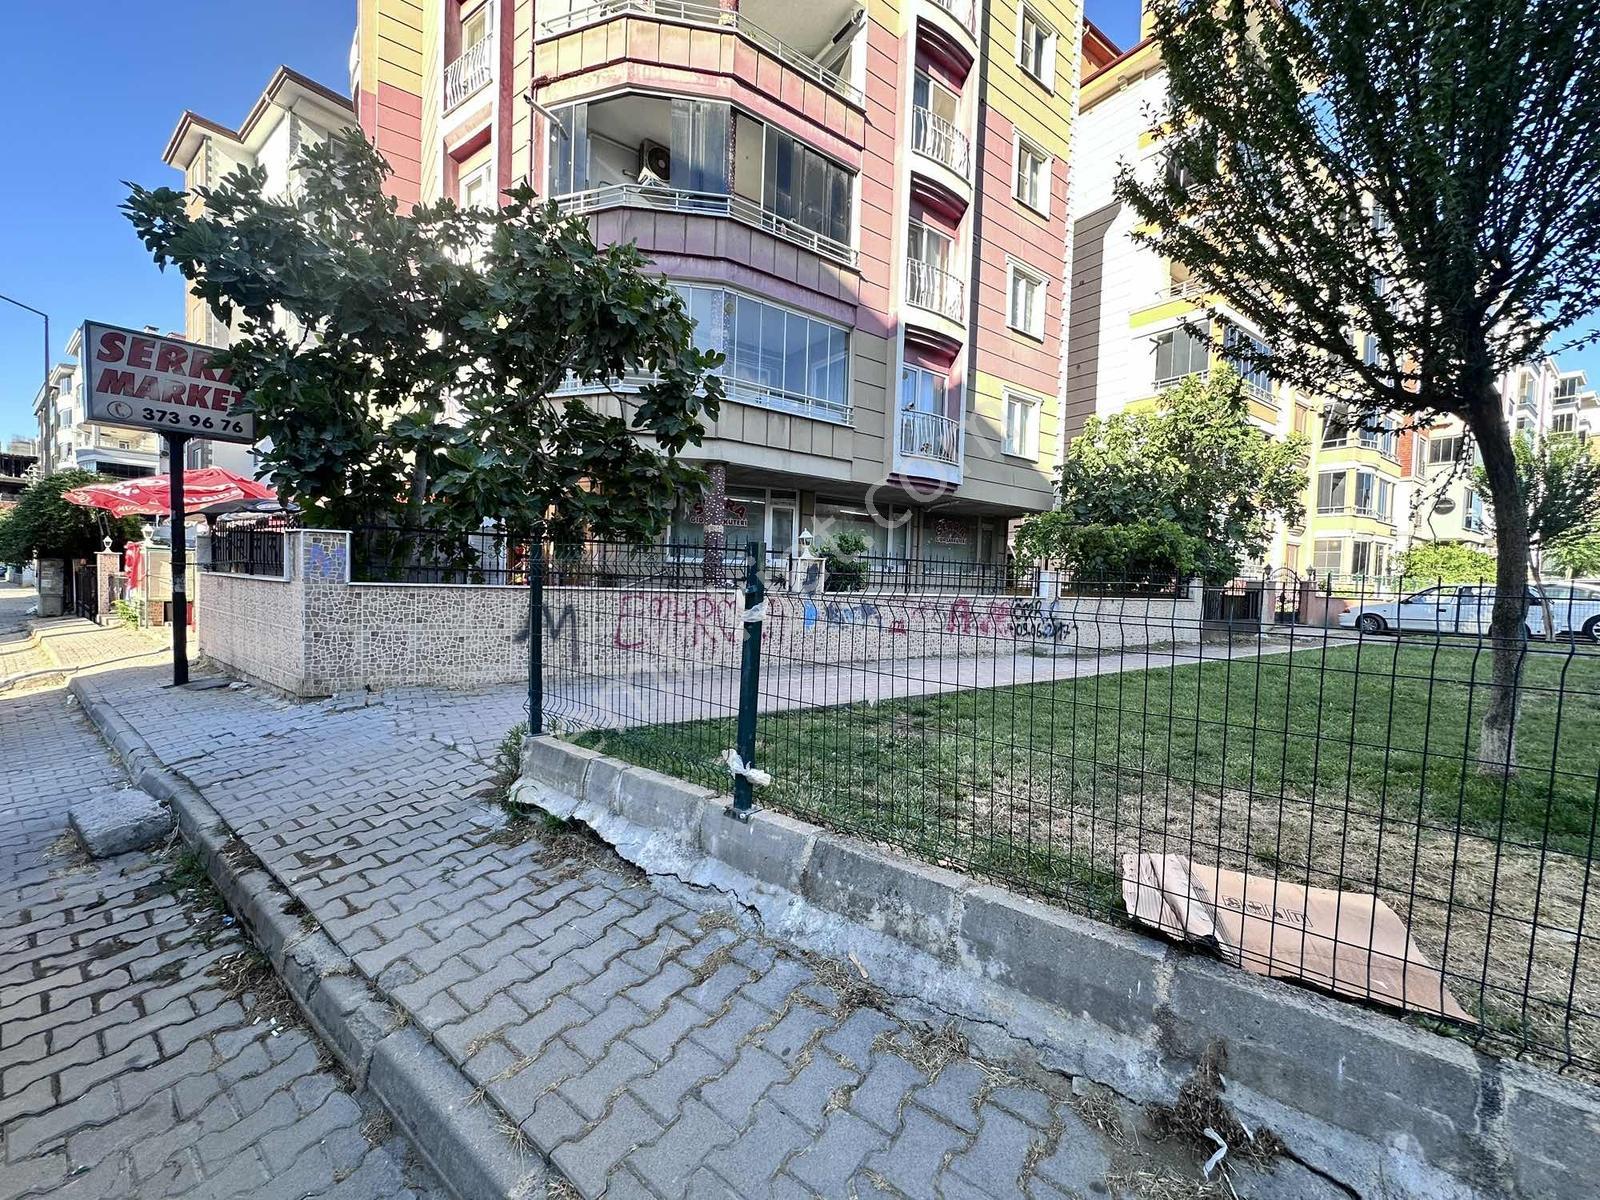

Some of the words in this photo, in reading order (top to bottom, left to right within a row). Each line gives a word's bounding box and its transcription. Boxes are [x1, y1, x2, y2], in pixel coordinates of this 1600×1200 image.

[142, 407, 181, 425] 373
[189, 414, 214, 429] 96
[220, 419, 244, 433] 76
[693, 499, 746, 518] SRA
